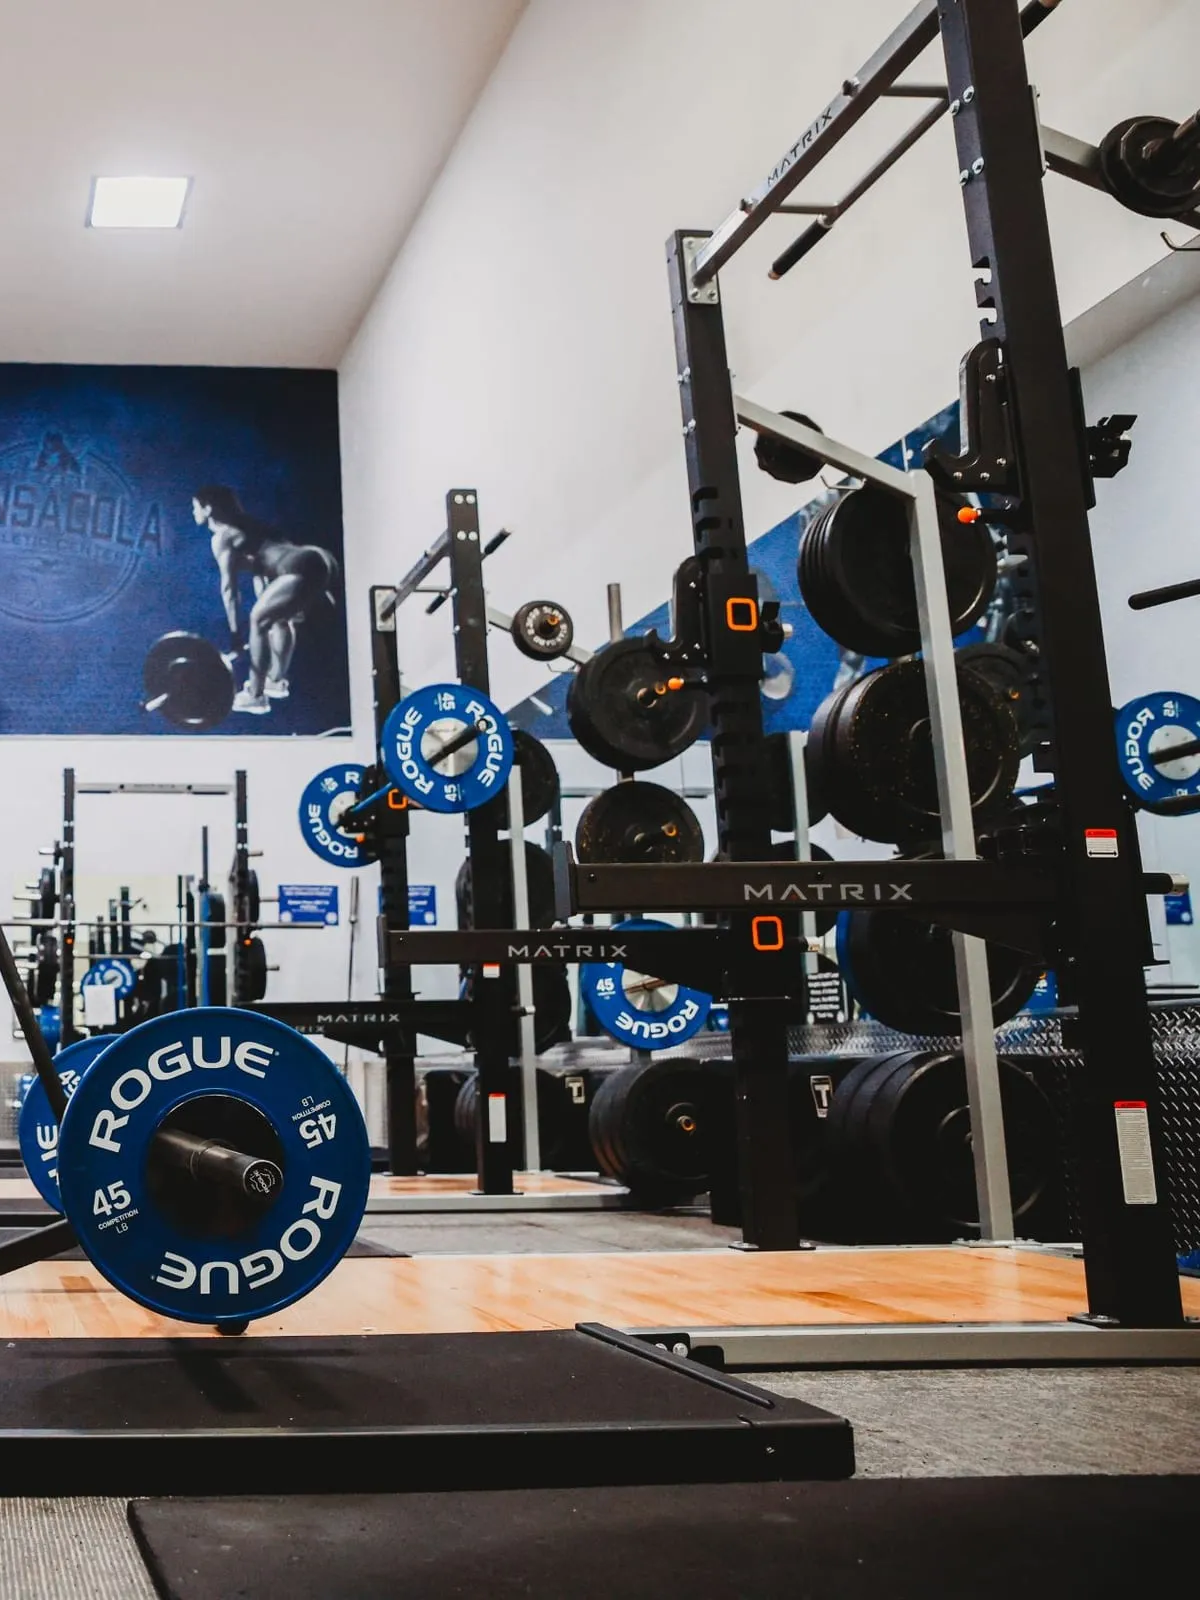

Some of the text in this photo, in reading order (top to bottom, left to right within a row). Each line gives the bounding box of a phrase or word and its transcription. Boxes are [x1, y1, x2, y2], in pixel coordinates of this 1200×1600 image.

[767, 107, 832, 187] MATRIX
[442, 692, 456, 711] 45
[396, 706, 434, 795] ROGUE
[465, 700, 503, 787] ROGUE
[444, 784, 457, 802] 45
[308, 804, 358, 858] ROGUE
[744, 884, 913, 900] MATRIX
[508, 945, 627, 957] MATRIX
[596, 977, 616, 991] 45
[317, 1014, 399, 1022] MATRIX
[615, 1000, 700, 1039] ROGUE
[89, 1036, 274, 1152] ROGUE
[302, 1096, 314, 1107] LB
[291, 1099, 331, 1121] COMPETITION
[299, 1113, 337, 1149] 45
[93, 1180, 132, 1216] 45
[98, 1208, 139, 1230] COMPETITION
[116, 1222, 129, 1234] LB
[156, 1174, 342, 1295] ROGUE
